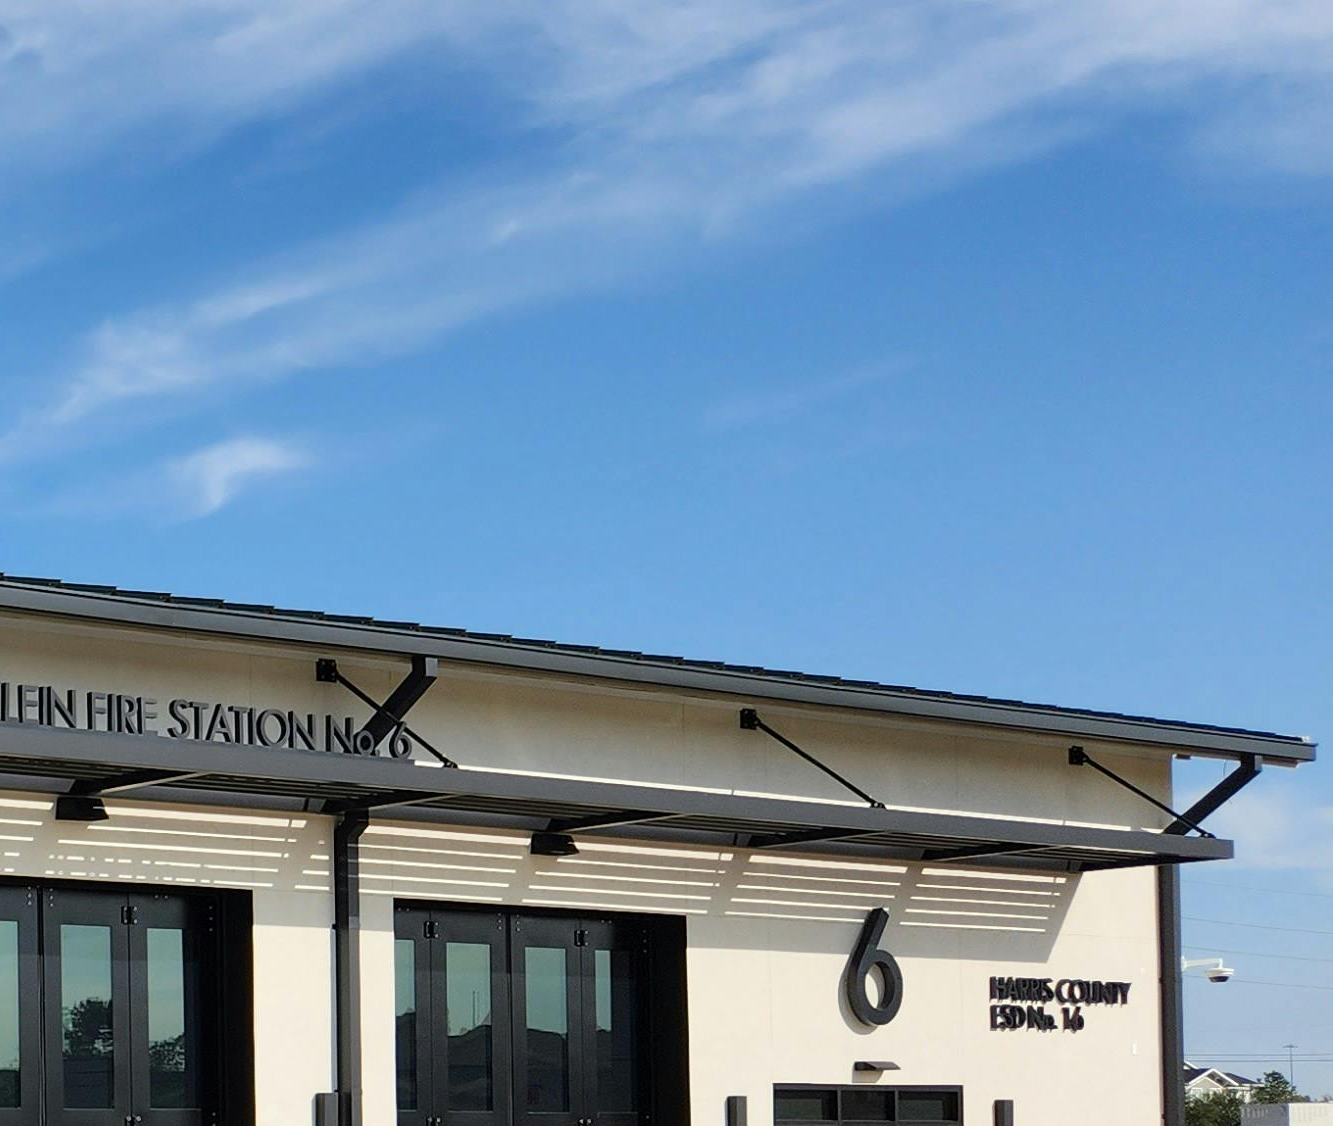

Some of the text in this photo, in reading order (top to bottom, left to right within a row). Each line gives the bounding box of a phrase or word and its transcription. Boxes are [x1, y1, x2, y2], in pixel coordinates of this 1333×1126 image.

[87, 691, 158, 736] FIRE
[167, 699, 318, 751] STATION
[325, 714, 380, 757] No.
[389, 720, 413, 759] 6
[845, 907, 904, 1026] 6
[989, 976, 1132, 1005] HARRIS COUNTY
[990, 1005, 1026, 1030] ESD
[1061, 1007, 1085, 1031] 16
